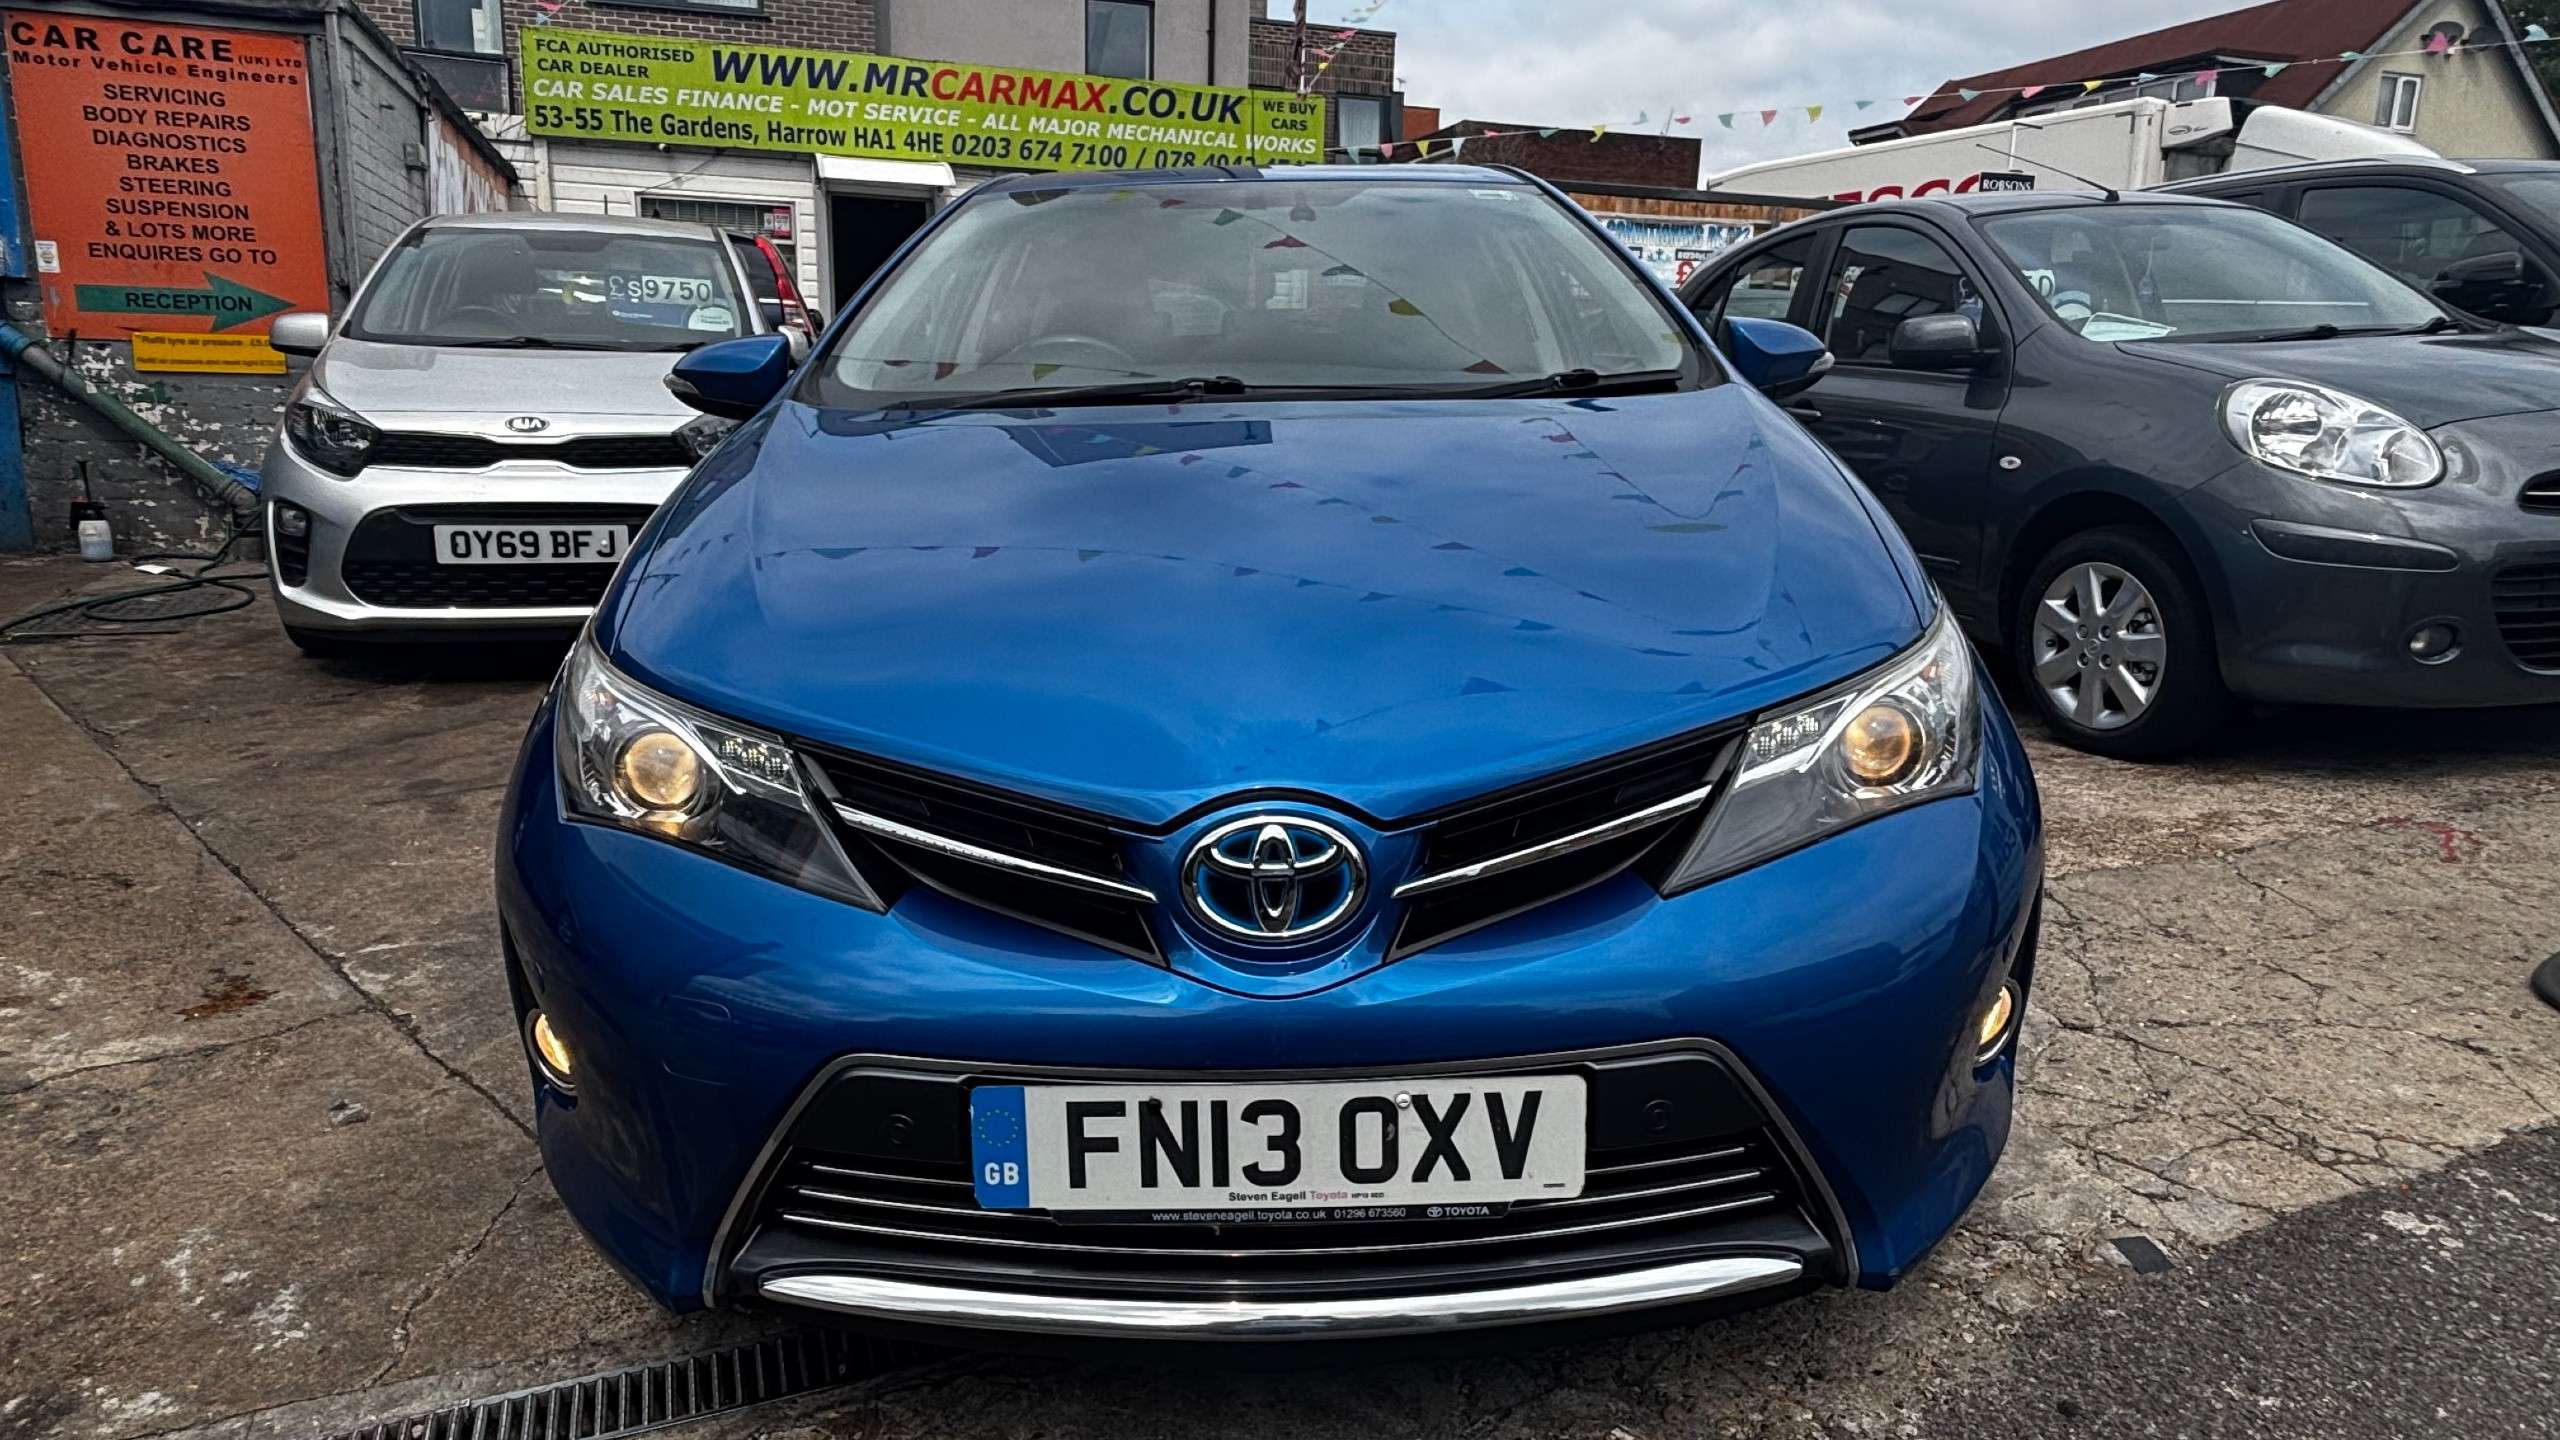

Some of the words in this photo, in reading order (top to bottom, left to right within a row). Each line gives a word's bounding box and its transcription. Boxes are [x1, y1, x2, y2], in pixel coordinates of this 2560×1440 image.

[11, 22, 100, 51] CAR
[120, 31, 234, 63] CARE
[238, 55, 270, 68] (UK)
[276, 57, 302, 68] LTD
[535, 38, 571, 54] FCA
[576, 42, 695, 63] AUTHORISED
[13, 50, 81, 68] Motor
[91, 56, 177, 76] Vehicle
[187, 64, 298, 85] Engineers
[537, 58, 574, 74] CAR
[580, 62, 649, 79] DEALER
[104, 84, 226, 107] SERVICING
[712, 50, 1246, 125] WWW.MRCARMAX.CO.UK
[83, 105, 147, 125] BODY
[155, 110, 251, 132] REPAIRS
[533, 79, 583, 99] CAR
[591, 82, 668, 105] SALES
[676, 90, 784, 113] FINANCE
[808, 98, 859, 119] MOT
[863, 103, 961, 127] SERVICE
[981, 113, 1021, 132] ALL
[1028, 116, 1101, 138] MAJOR
[1106, 123, 1238, 149] MECHANICAL
[1244, 134, 1317, 155] WORKS
[1262, 99, 1285, 113] WE
[1289, 101, 1318, 117] BUY
[1271, 118, 1308, 131] CARS
[93, 129, 247, 154] DIAGNOSTICS
[534, 104, 604, 132] 53-55
[610, 109, 653, 135] The
[660, 114, 760, 145] Gardens,
[767, 120, 846, 147] Harrow
[854, 126, 896, 151] HA1
[903, 130, 943, 154] 4HE
[951, 132, 1010, 160] 0203
[1019, 137, 1062, 163] 674
[1071, 143, 1127, 169] 7100
[1154, 149, 1197, 169] 078
[127, 153, 220, 174] BRAKES
[119, 176, 232, 198] STEERING
[106, 198, 249, 220] SUSPENSION
[105, 221, 121, 236] &
[128, 221, 185, 239] LOTS
[192, 224, 257, 243] MORE
[88, 243, 203, 263] ENQUIRES
[209, 246, 242, 264] GO
[247, 248, 278, 265] TO
[125, 290, 253, 312] RECEPTION
[510, 416, 545, 431] KIA
[449, 530, 541, 559] OY69
[550, 530, 616, 558] BFJ
[1065, 1098, 1302, 1189] FN13
[1338, 1090, 1544, 1184] OXV
[984, 1160, 1020, 1185] GB
[1228, 1191, 1268, 1201] Steven
[1271, 1191, 1306, 1202] Eagell
[1309, 1190, 1348, 1202] Toyota
[1333, 1208, 1365, 1219] 01296
[1443, 1205, 1490, 1216] TOYOTA
